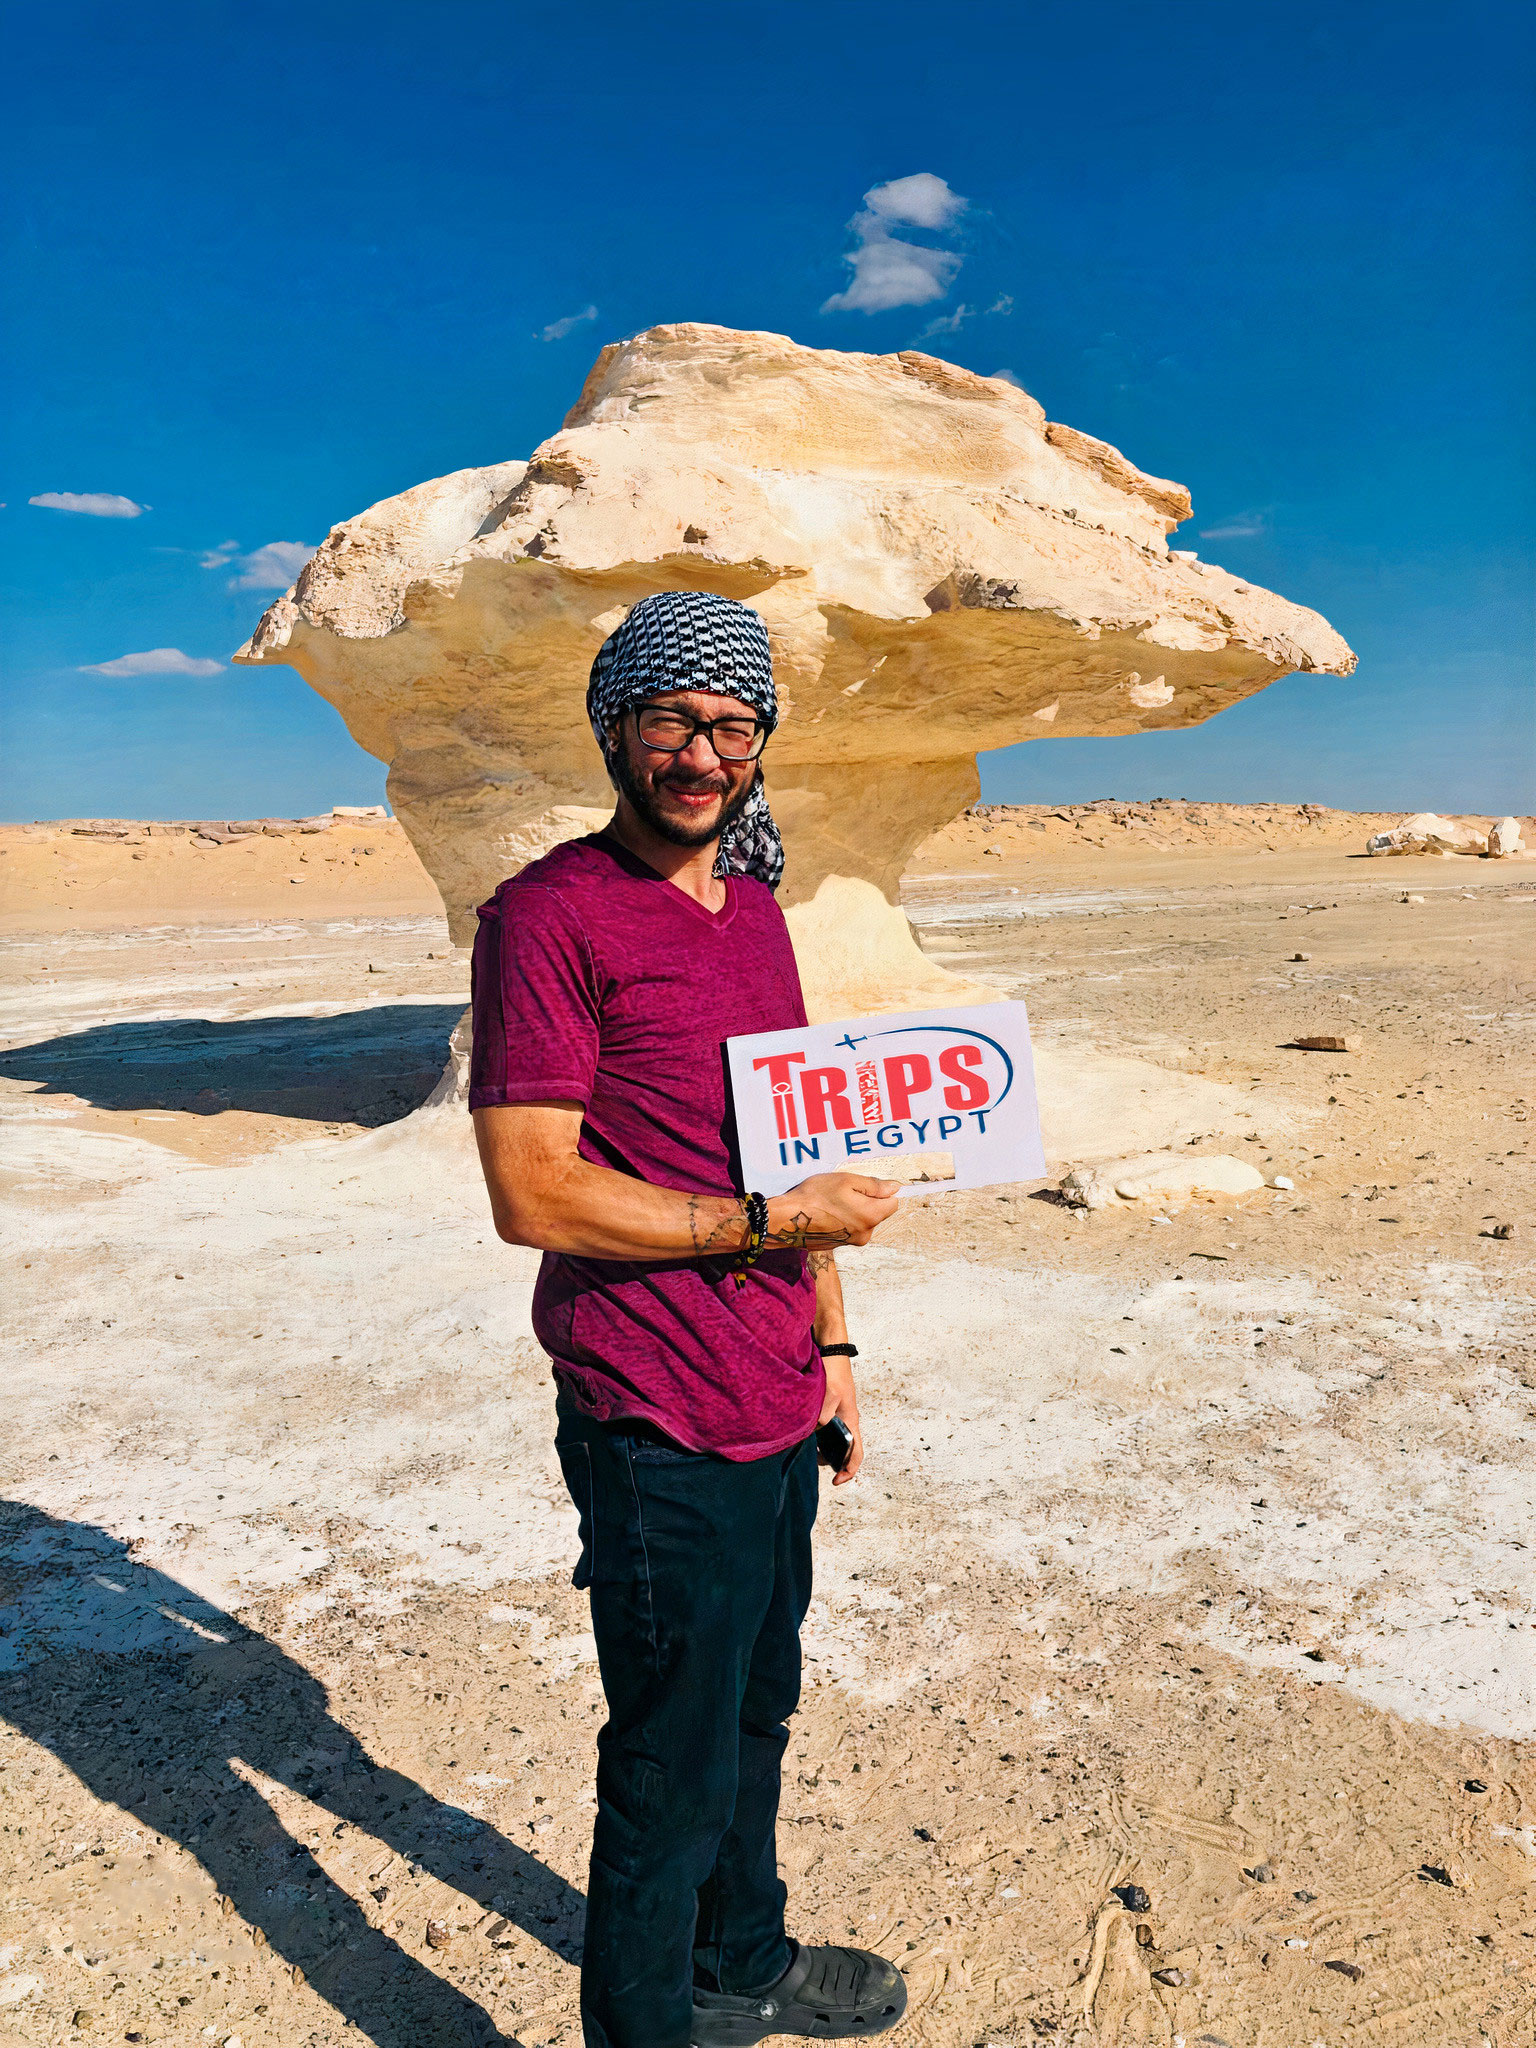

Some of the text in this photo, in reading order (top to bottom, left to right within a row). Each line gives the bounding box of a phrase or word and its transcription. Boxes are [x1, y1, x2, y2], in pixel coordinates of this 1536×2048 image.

[753, 1045, 990, 1139] TRIPS
[779, 1109, 991, 1165] IN EGYPT
